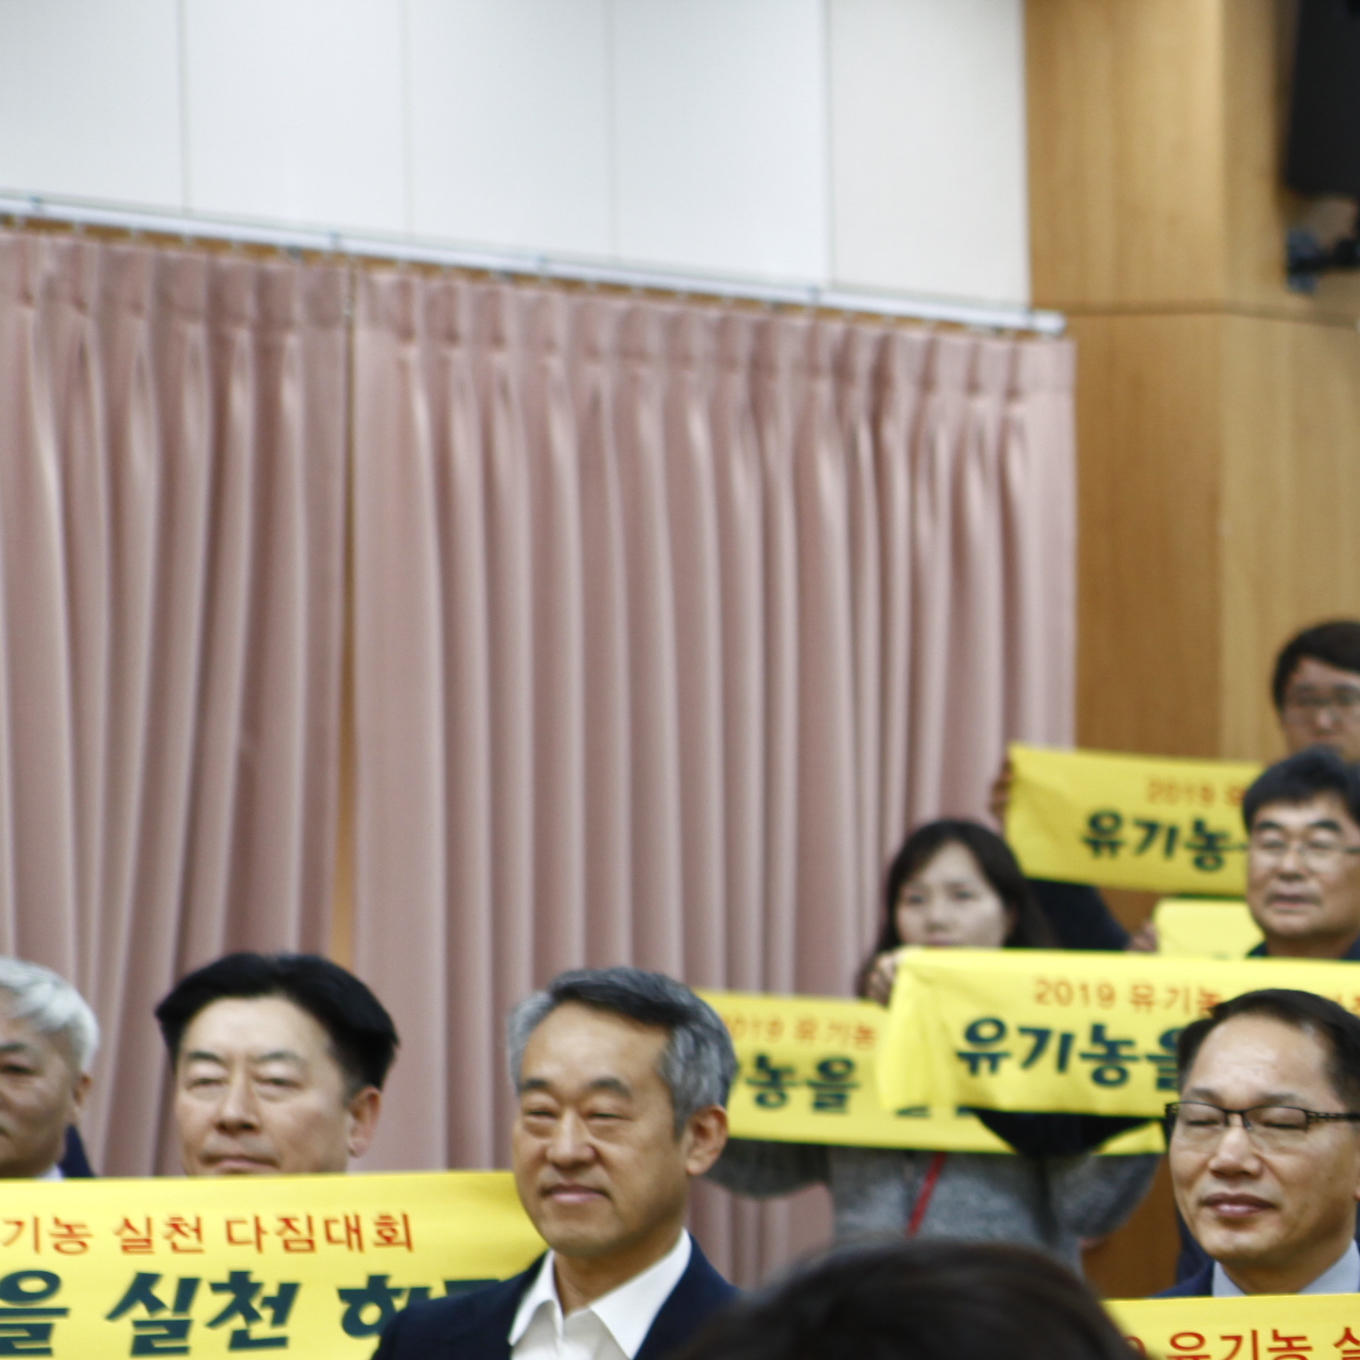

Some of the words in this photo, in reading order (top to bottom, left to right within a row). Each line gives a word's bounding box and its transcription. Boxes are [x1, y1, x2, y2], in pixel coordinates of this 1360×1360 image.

[1083, 808, 1248, 873] 유기농
[745, 1054, 857, 1113] 농을
[3, 1215, 94, 1256] 기농
[112, 1214, 206, 1256] 실천
[225, 1212, 415, 1254] 다짐대회
[106, 1270, 301, 1358] 실천
